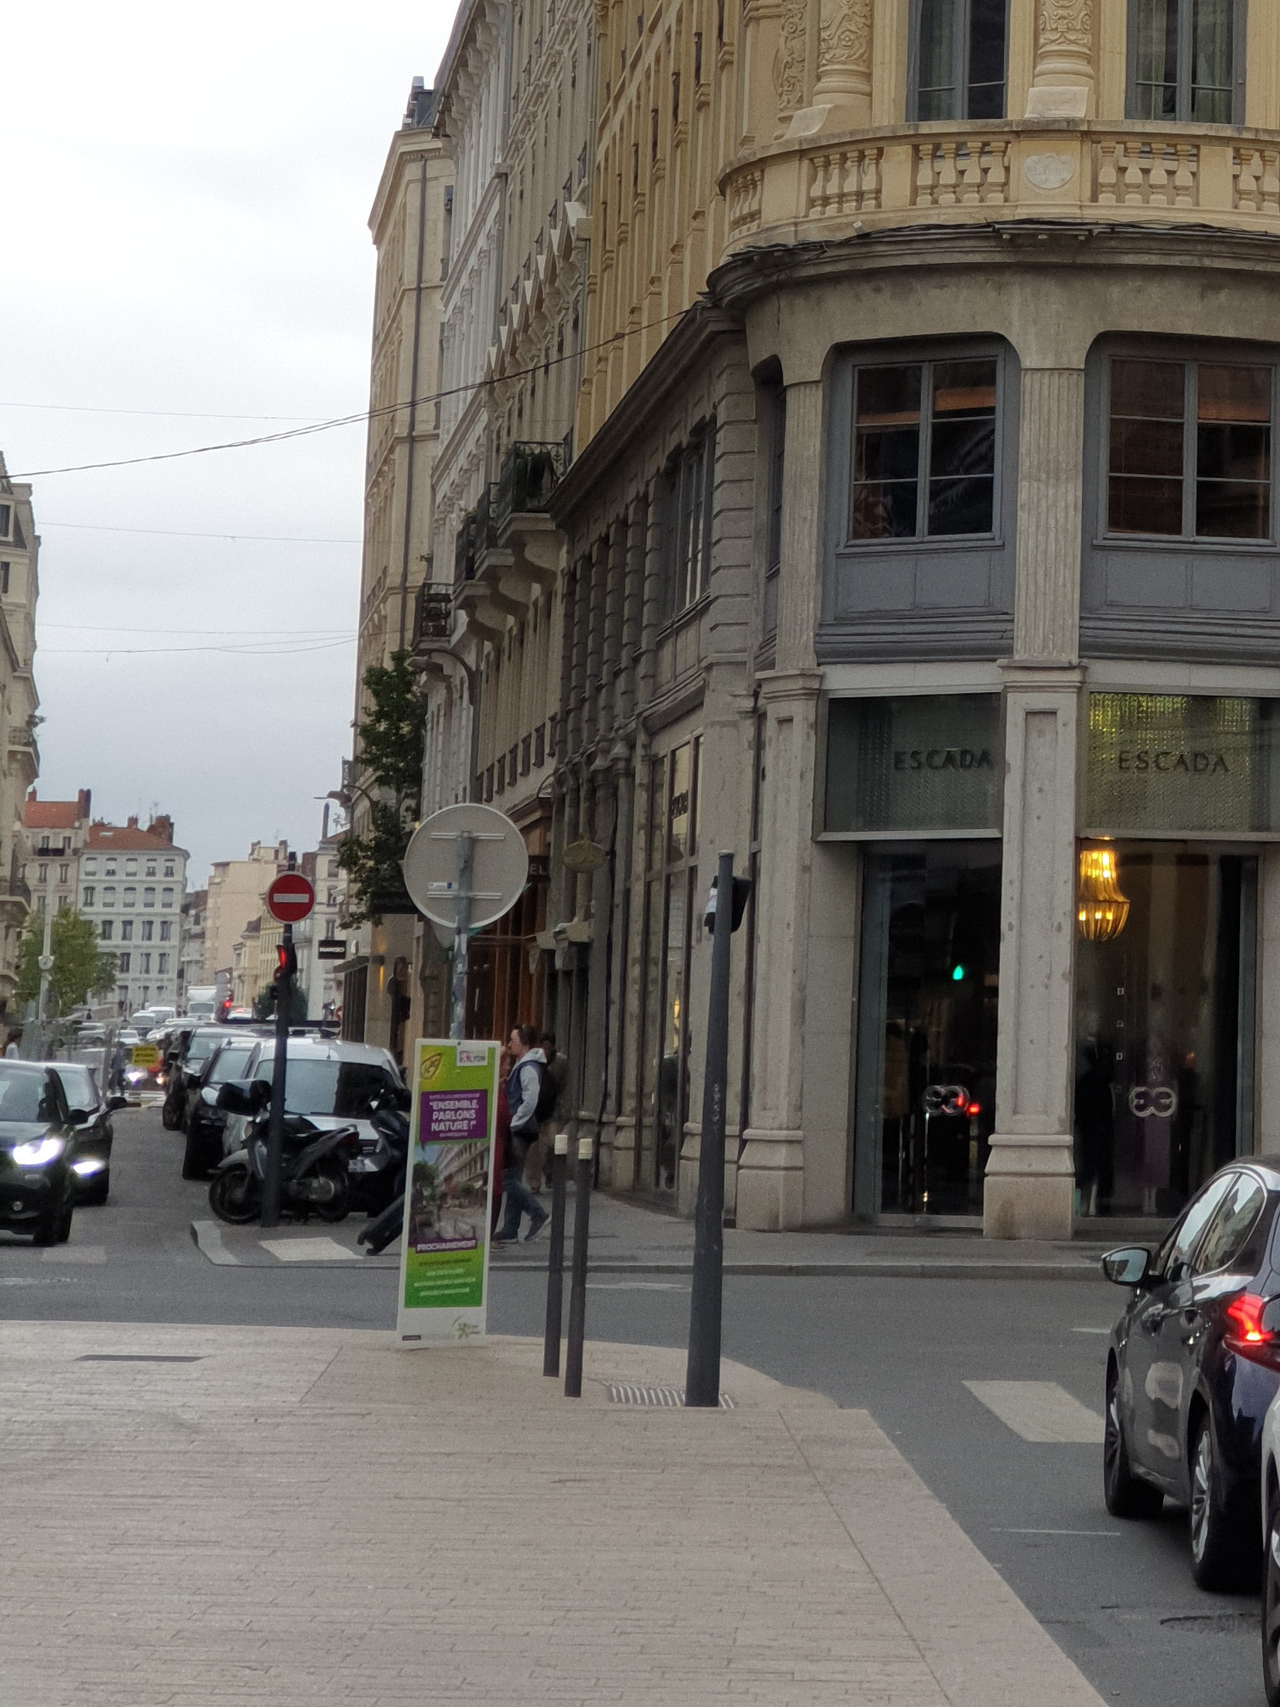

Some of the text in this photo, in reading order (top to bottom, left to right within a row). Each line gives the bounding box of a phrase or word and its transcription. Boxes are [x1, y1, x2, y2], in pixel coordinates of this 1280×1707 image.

[894, 749, 996, 771] ESCADA
[1118, 750, 1230, 774] ESCADA
[432, 1109, 476, 1121] PARLONS
[431, 1120, 469, 1132] NATURE
